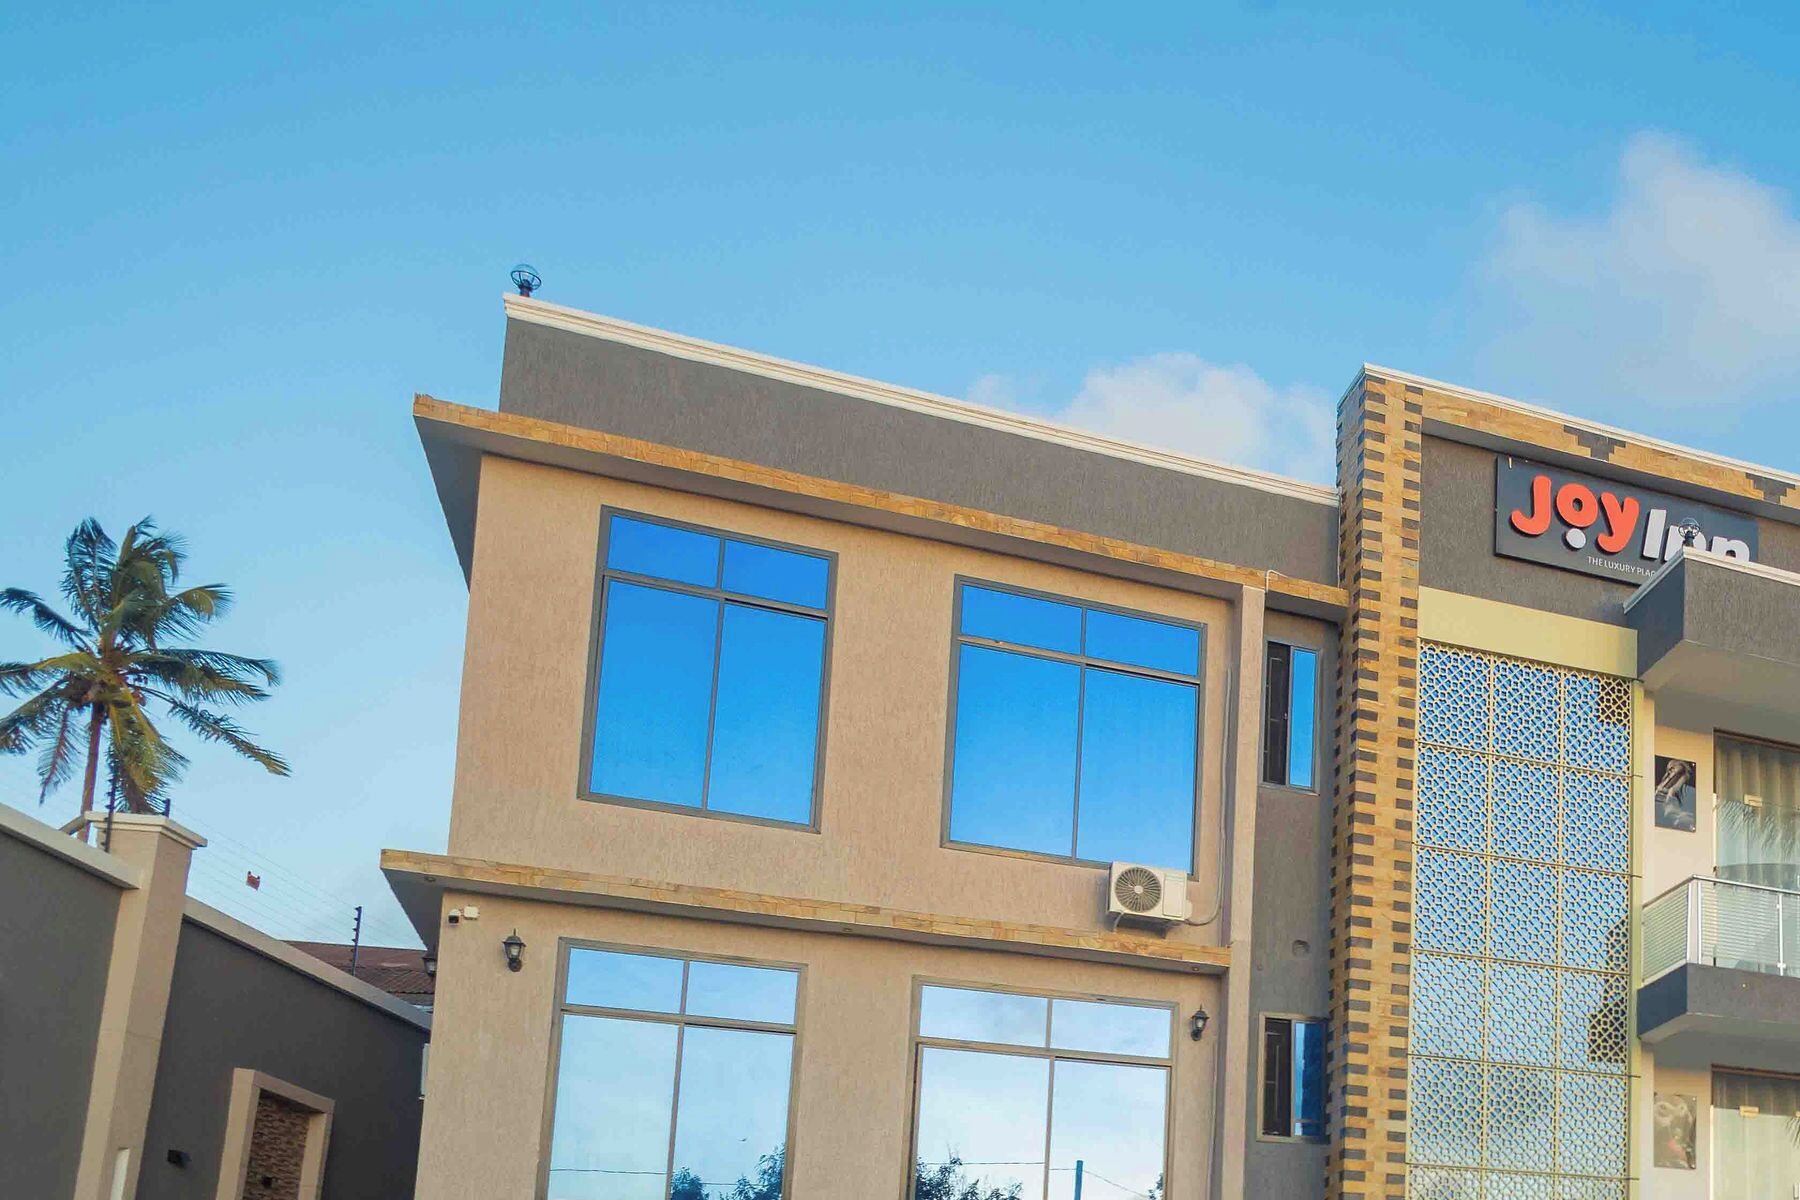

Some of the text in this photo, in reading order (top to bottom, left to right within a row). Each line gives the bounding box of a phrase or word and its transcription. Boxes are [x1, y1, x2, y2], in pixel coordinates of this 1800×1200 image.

[1642, 508, 1750, 562] Inn
[1587, 555, 1604, 567] THE
[1604, 559, 1636, 573] LUXURY
